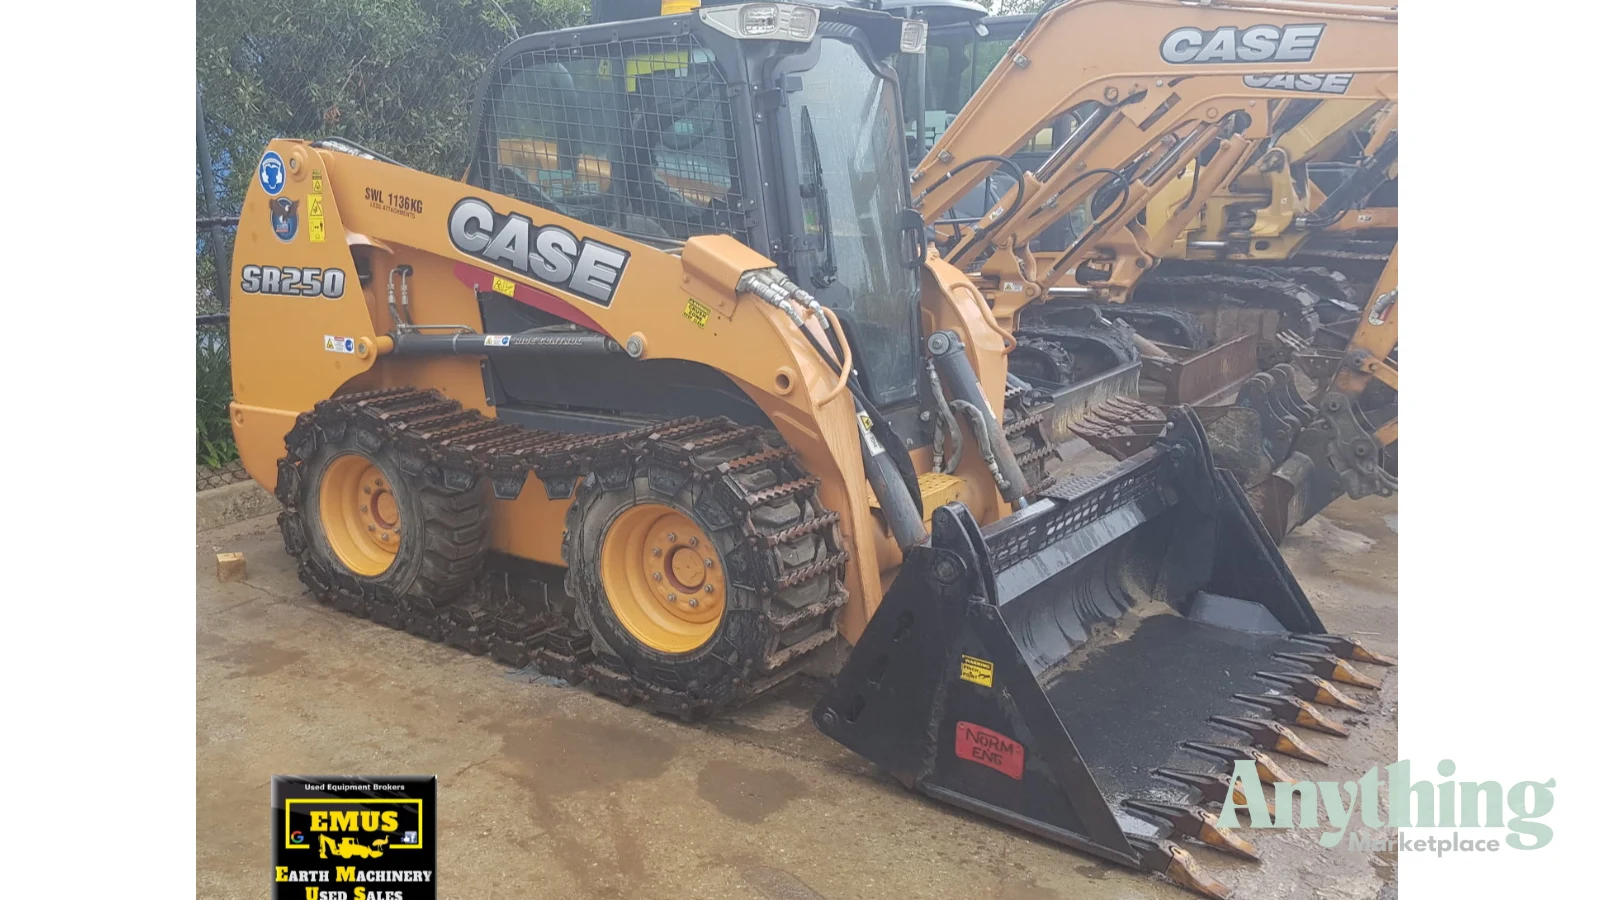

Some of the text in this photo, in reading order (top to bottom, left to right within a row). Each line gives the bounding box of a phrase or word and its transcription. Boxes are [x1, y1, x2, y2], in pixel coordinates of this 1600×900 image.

[1160, 23, 1327, 65] CASE
[1243, 73, 1354, 94] CASE
[365, 187, 423, 214] SWL 1136KG
[370, 201, 416, 219] LESS ATTACHMENTS
[448, 197, 631, 307] CASE
[241, 264, 345, 299] SR250
[963, 665, 979, 673] PINCH
[964, 658, 990, 669] WARNING
[972, 746, 1003, 766] ENG
